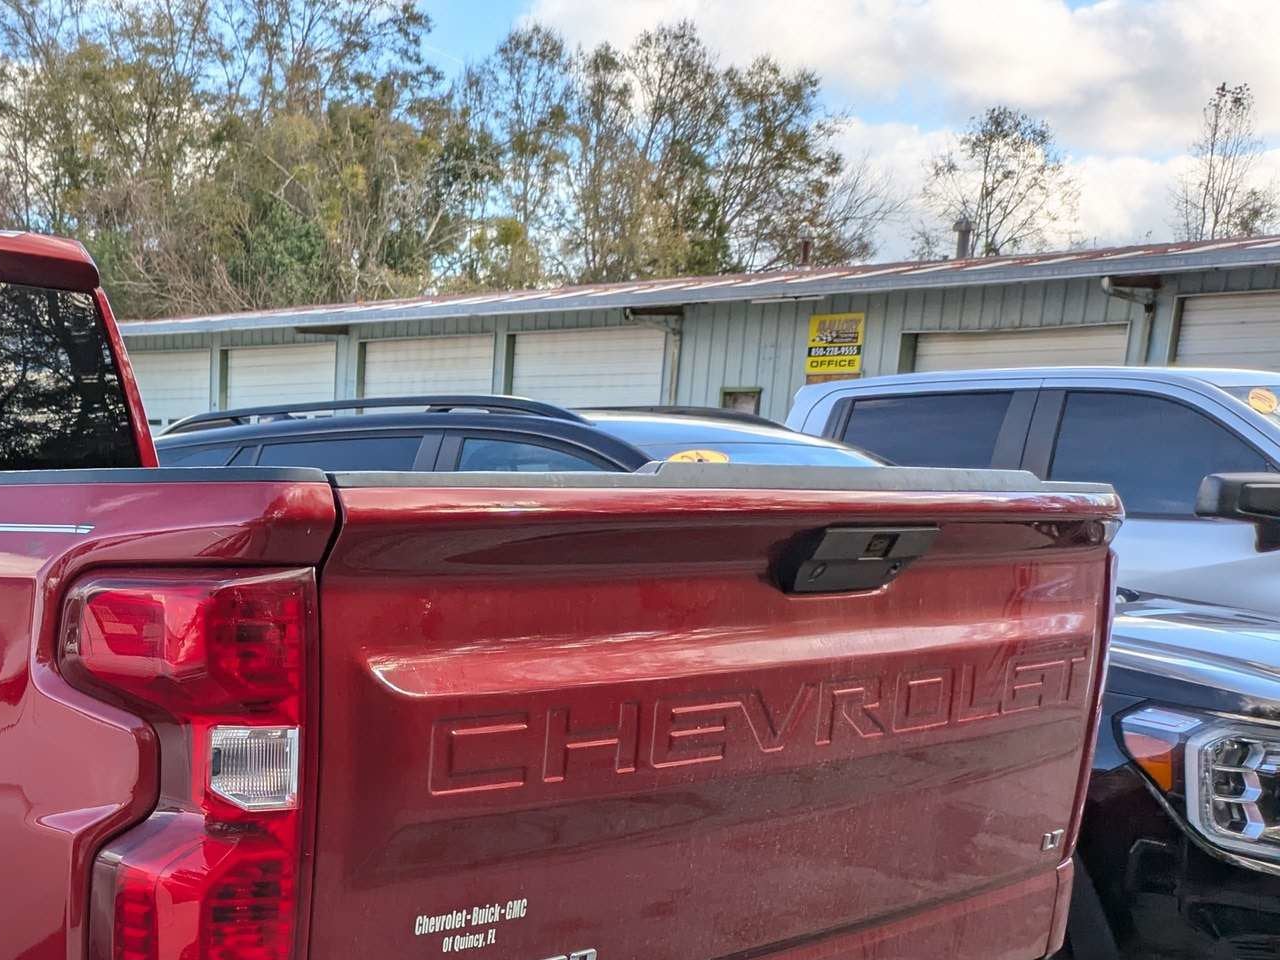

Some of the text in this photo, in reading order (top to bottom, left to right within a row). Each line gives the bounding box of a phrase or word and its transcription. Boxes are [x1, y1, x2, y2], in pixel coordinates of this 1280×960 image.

[810, 359, 856, 368] OFFICE
[430, 649, 1087, 796] CHEVROLET
[442, 928, 496, 953] Of Quincy, FL
